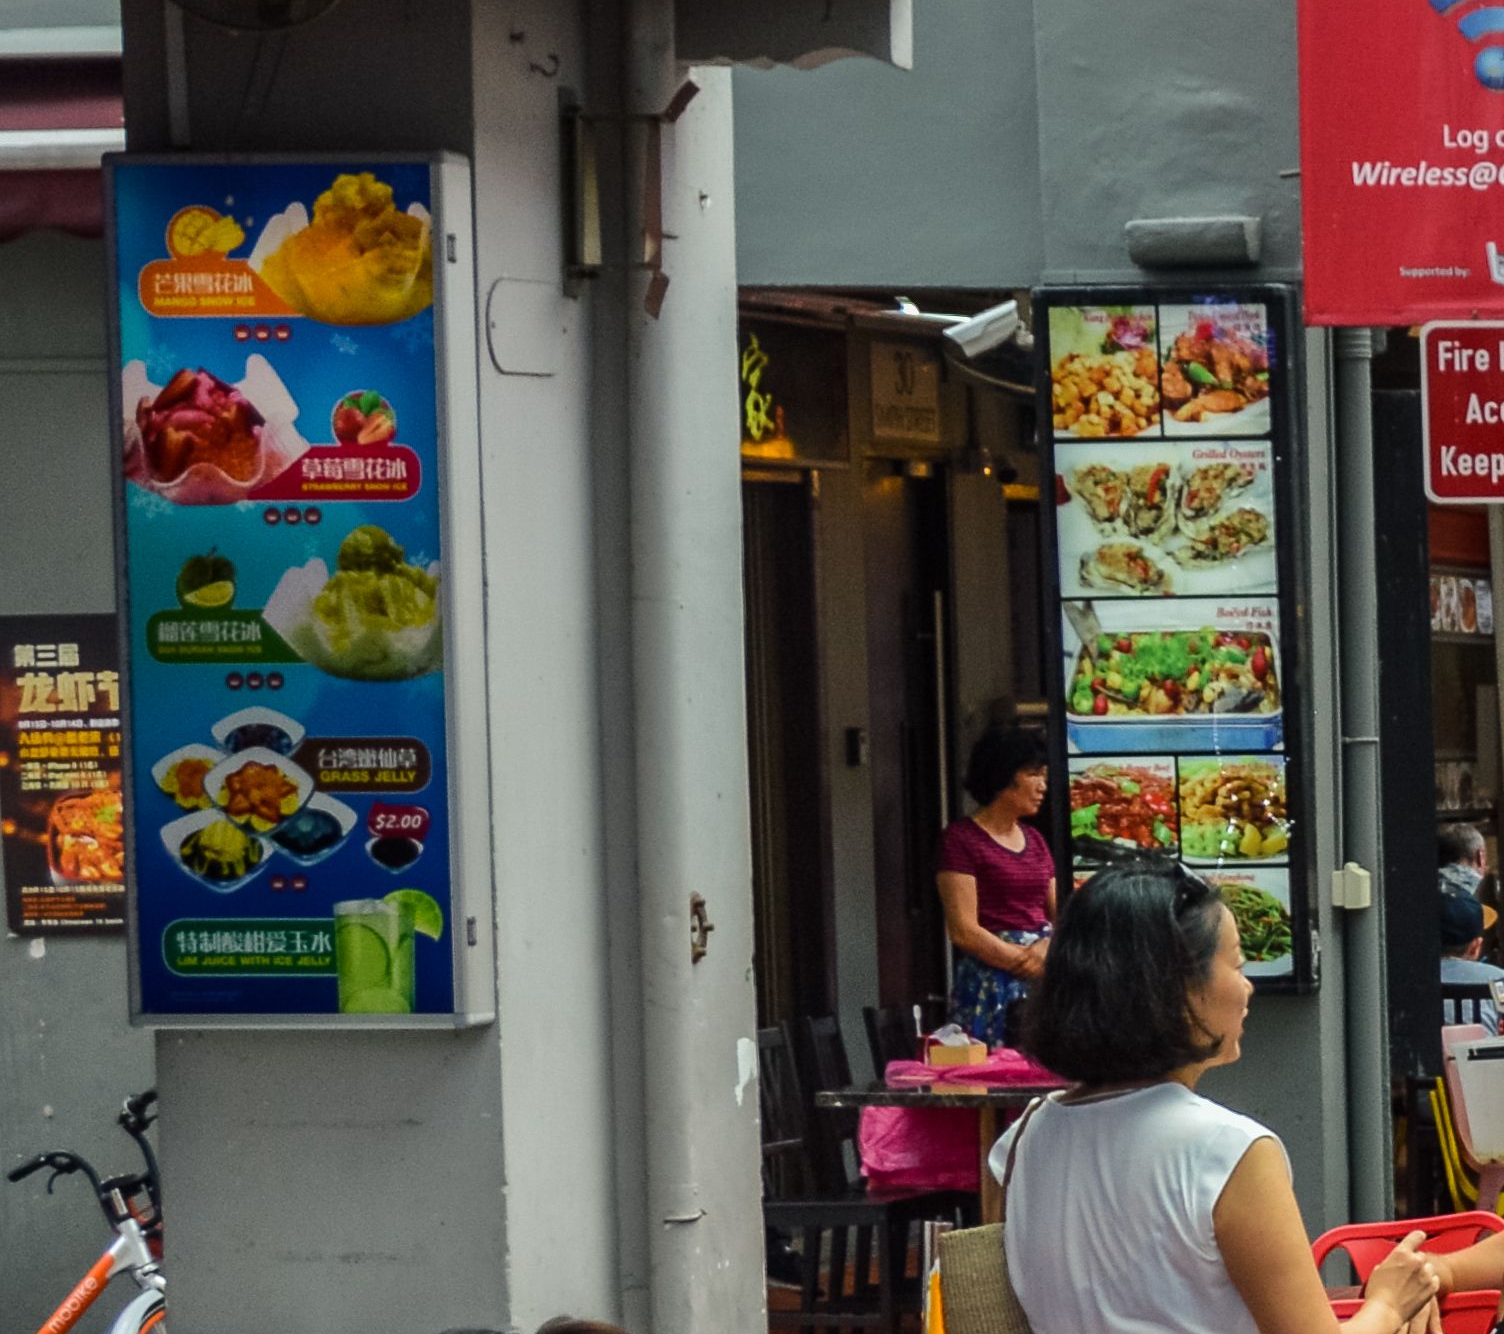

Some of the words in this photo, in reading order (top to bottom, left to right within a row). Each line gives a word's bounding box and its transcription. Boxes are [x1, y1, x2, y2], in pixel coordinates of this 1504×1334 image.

[1443, 124, 1490, 154] Log
[1400, 267, 1451, 280] Supported
[1438, 341, 1490, 371] Fire
[1192, 449, 1226, 460] Grilled
[302, 458, 407, 480] 草莓雪花冰
[302, 482, 362, 491] STRAWBERRY
[14, 643, 79, 667] 第三届
[320, 771, 370, 783] GRASS
[373, 771, 417, 783] JELLY
[375, 814, 422, 829] $2.00
[201, 956, 237, 967] JUICE
[240, 956, 270, 967] WITH
[273, 956, 295, 967] ICE
[298, 956, 331, 967] JELLY
[48, 1276, 98, 1334] mobike
